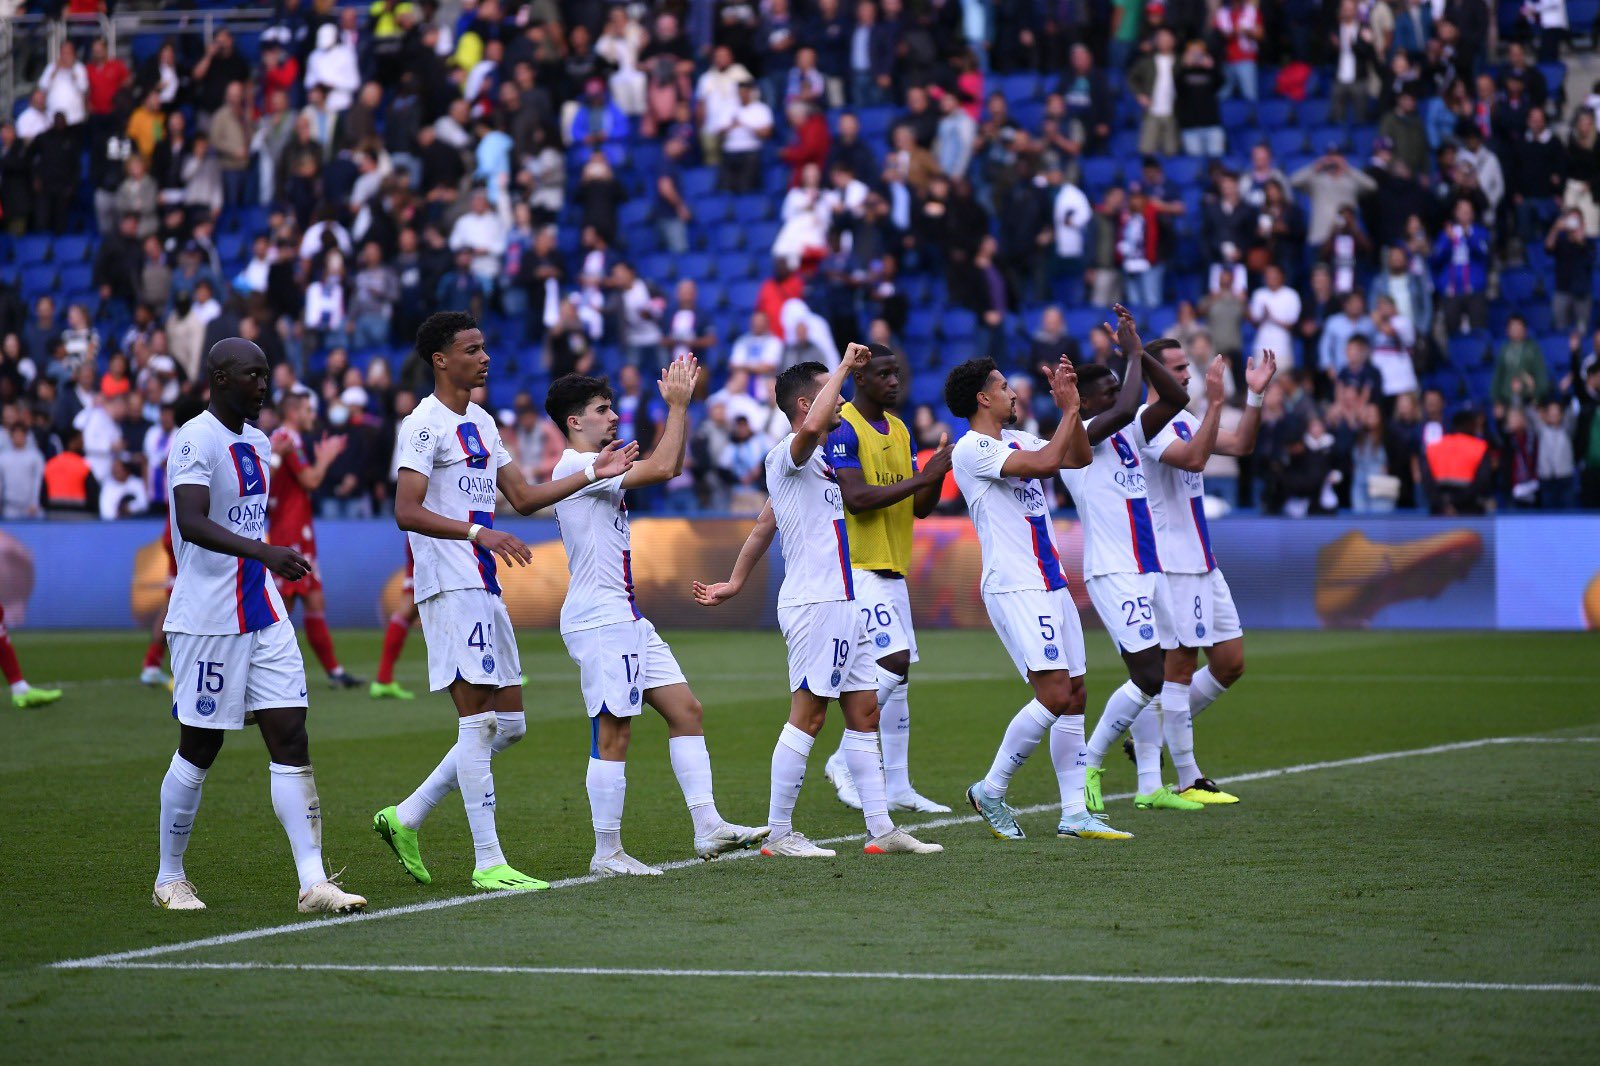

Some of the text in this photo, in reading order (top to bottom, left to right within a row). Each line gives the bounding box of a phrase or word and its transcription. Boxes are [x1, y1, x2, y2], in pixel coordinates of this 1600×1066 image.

[459, 475, 495, 495] QATAR
[228, 503, 266, 525] QATA
[860, 603, 892, 633] 26
[1121, 596, 1152, 626] 25
[1194, 595, 1202, 620] 8
[1038, 615, 1055, 641] 5
[832, 638, 850, 668] 19
[196, 661, 224, 694] 15
[622, 653, 640, 684] 17
